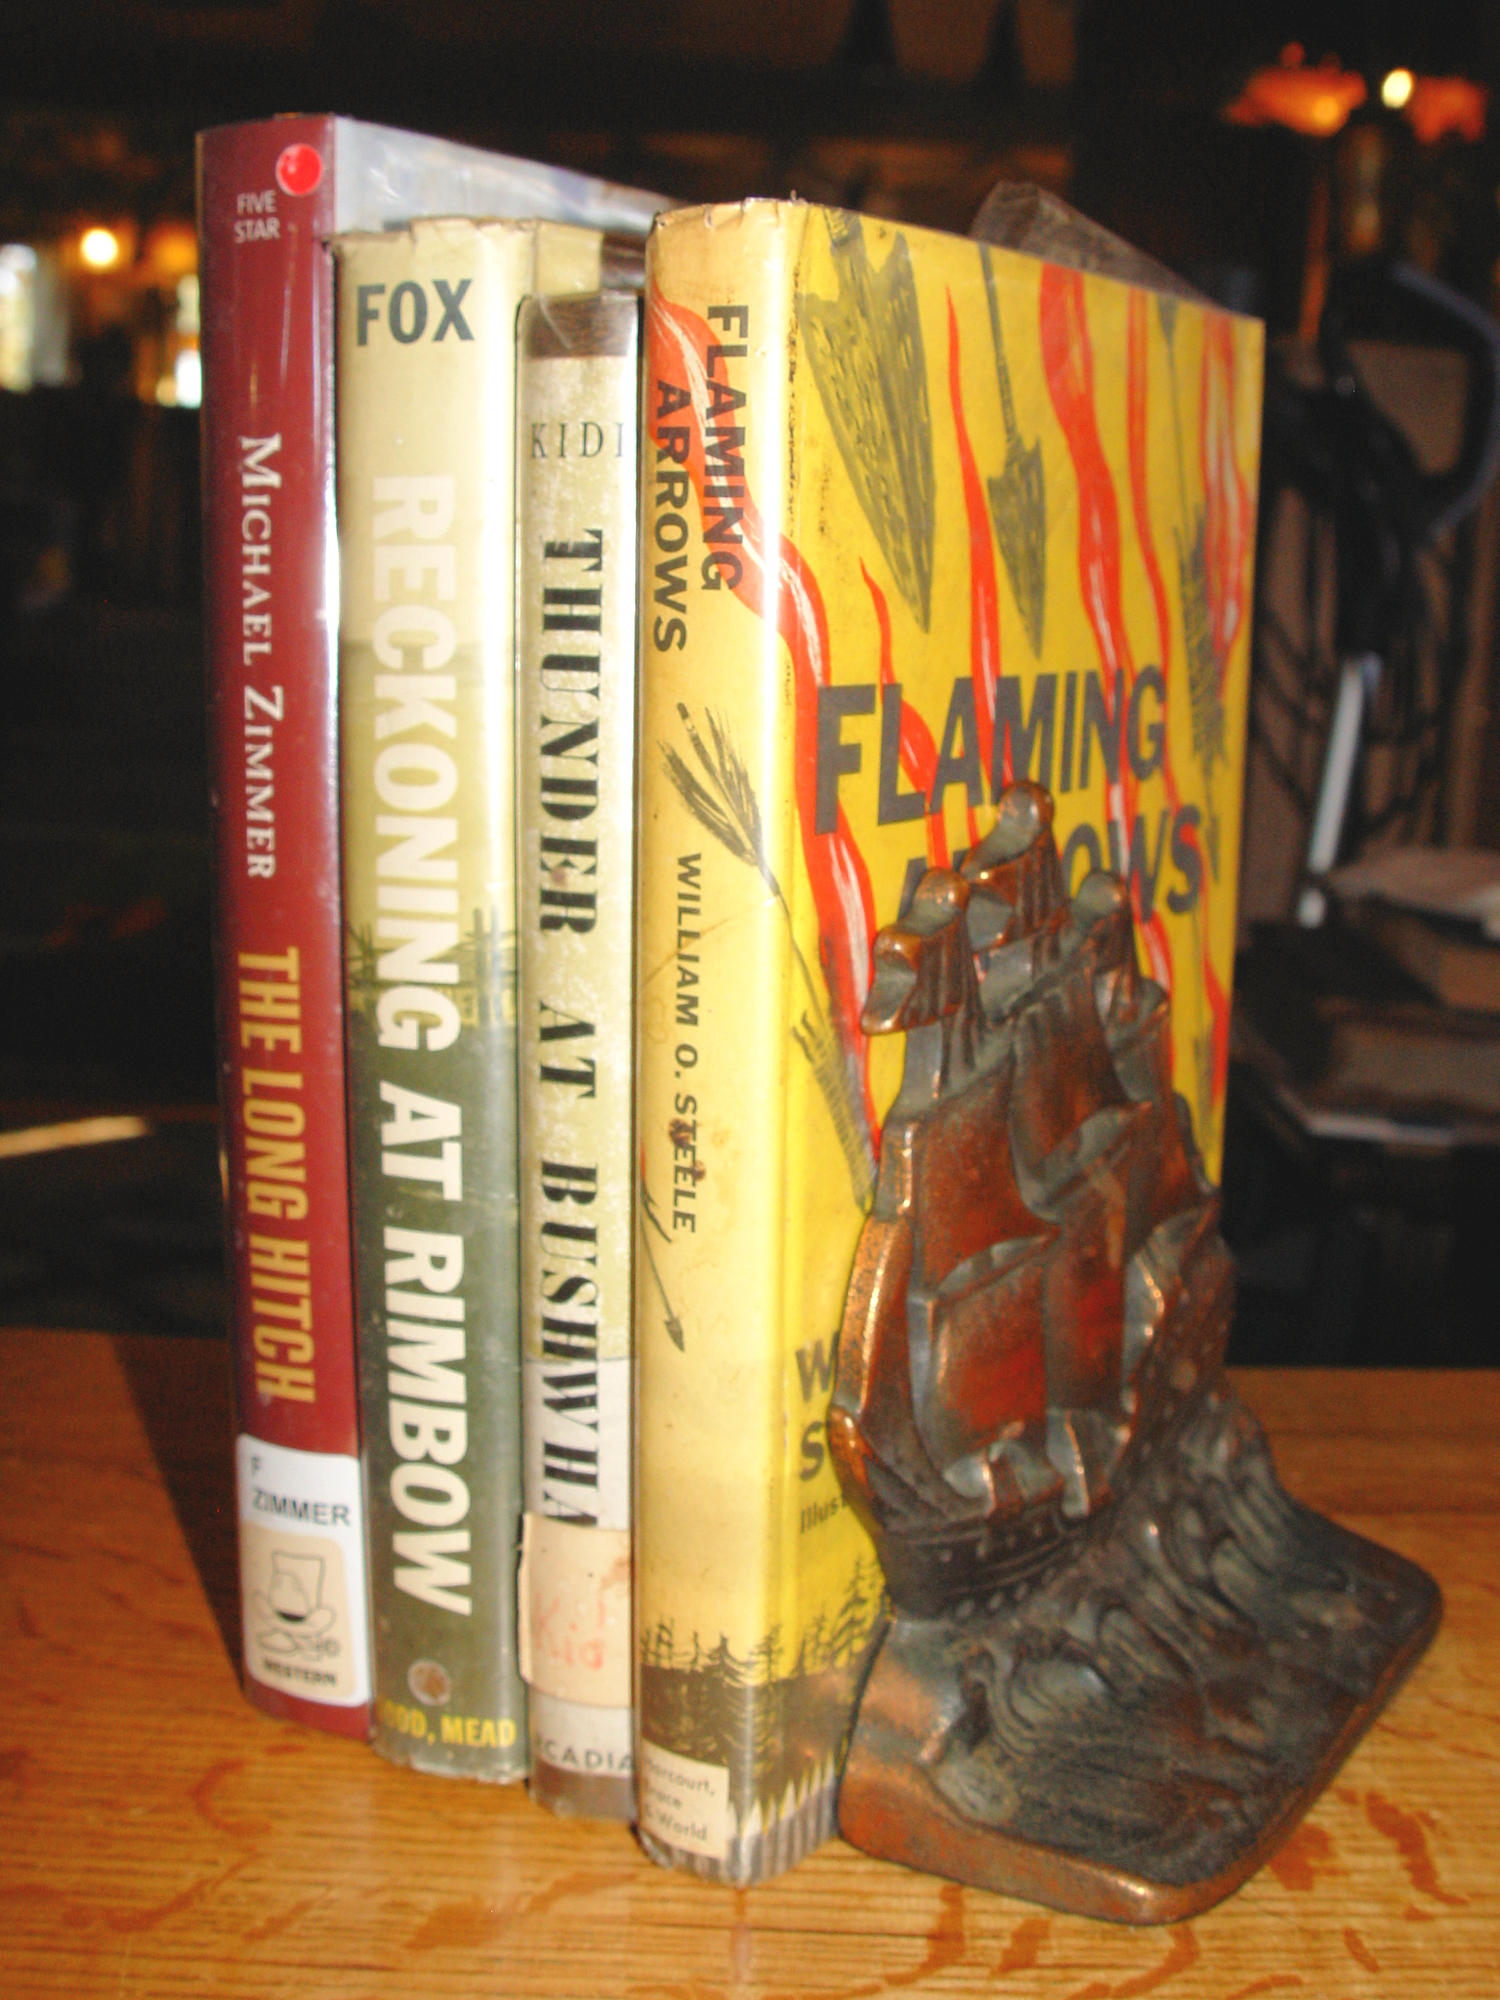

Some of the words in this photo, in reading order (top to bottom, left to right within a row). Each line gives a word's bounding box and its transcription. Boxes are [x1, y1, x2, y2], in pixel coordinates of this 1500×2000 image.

[234, 217, 281, 243] STAR
[237, 190, 277, 215] FIVE
[355, 278, 475, 346] FOX
[653, 379, 692, 652] ARROWS
[701, 305, 749, 591] FLAMING
[239, 433, 283, 665] MICHAEL
[243, 685, 284, 879] ZIMMER
[372, 474, 462, 1052] RECKONING
[540, 528, 603, 934] THUNDER
[814, 664, 1167, 836] FLAMING
[895, 803, 1201, 924] OWS
[238, 946, 303, 1054] THE
[675, 852, 702, 1027] WILLIAM
[540, 1000, 597, 1099] AT
[674, 1043, 699, 1079] O.
[242, 1068, 309, 1221] LONG
[379, 1080, 463, 1202] AT
[672, 1093, 699, 1233] STEELE
[249, 1232, 317, 1404] HITCH
[383, 1226, 473, 1617] RIMBOW
[252, 1487, 352, 1528] ZIMMER
[378, 1698, 436, 1746] ODD,
[440, 1714, 517, 1749] MEAD
[539, 1737, 633, 1771] CADIA
